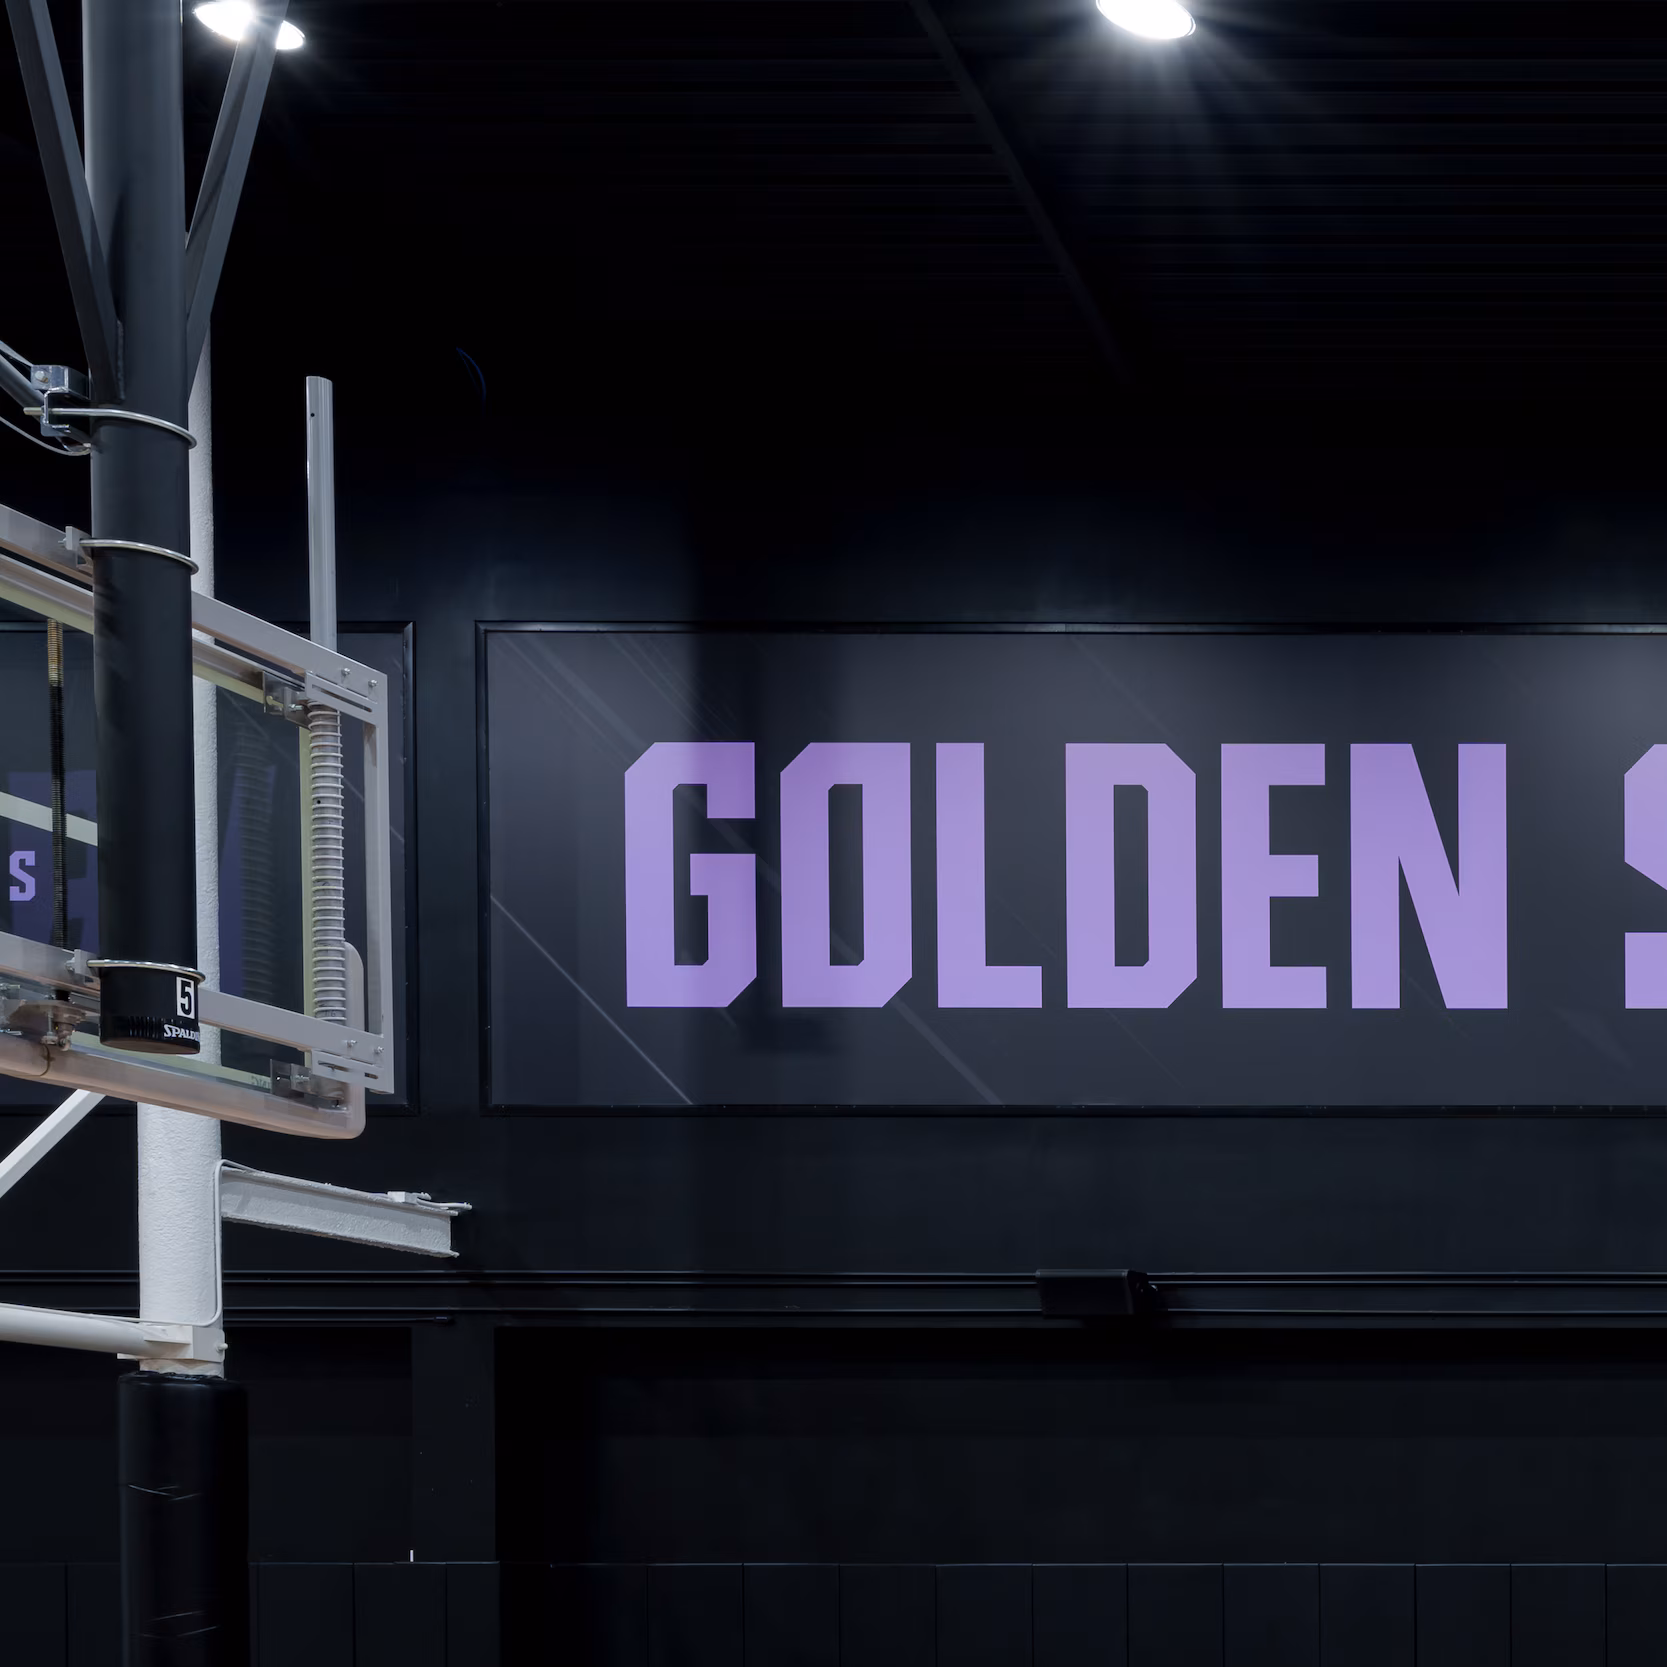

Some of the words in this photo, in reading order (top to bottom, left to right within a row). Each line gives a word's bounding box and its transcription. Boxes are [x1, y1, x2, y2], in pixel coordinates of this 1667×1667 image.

[625, 741, 1508, 1010] GOLDEN
[180, 979, 192, 1016] 5
[163, 1023, 200, 1041] SPALD
